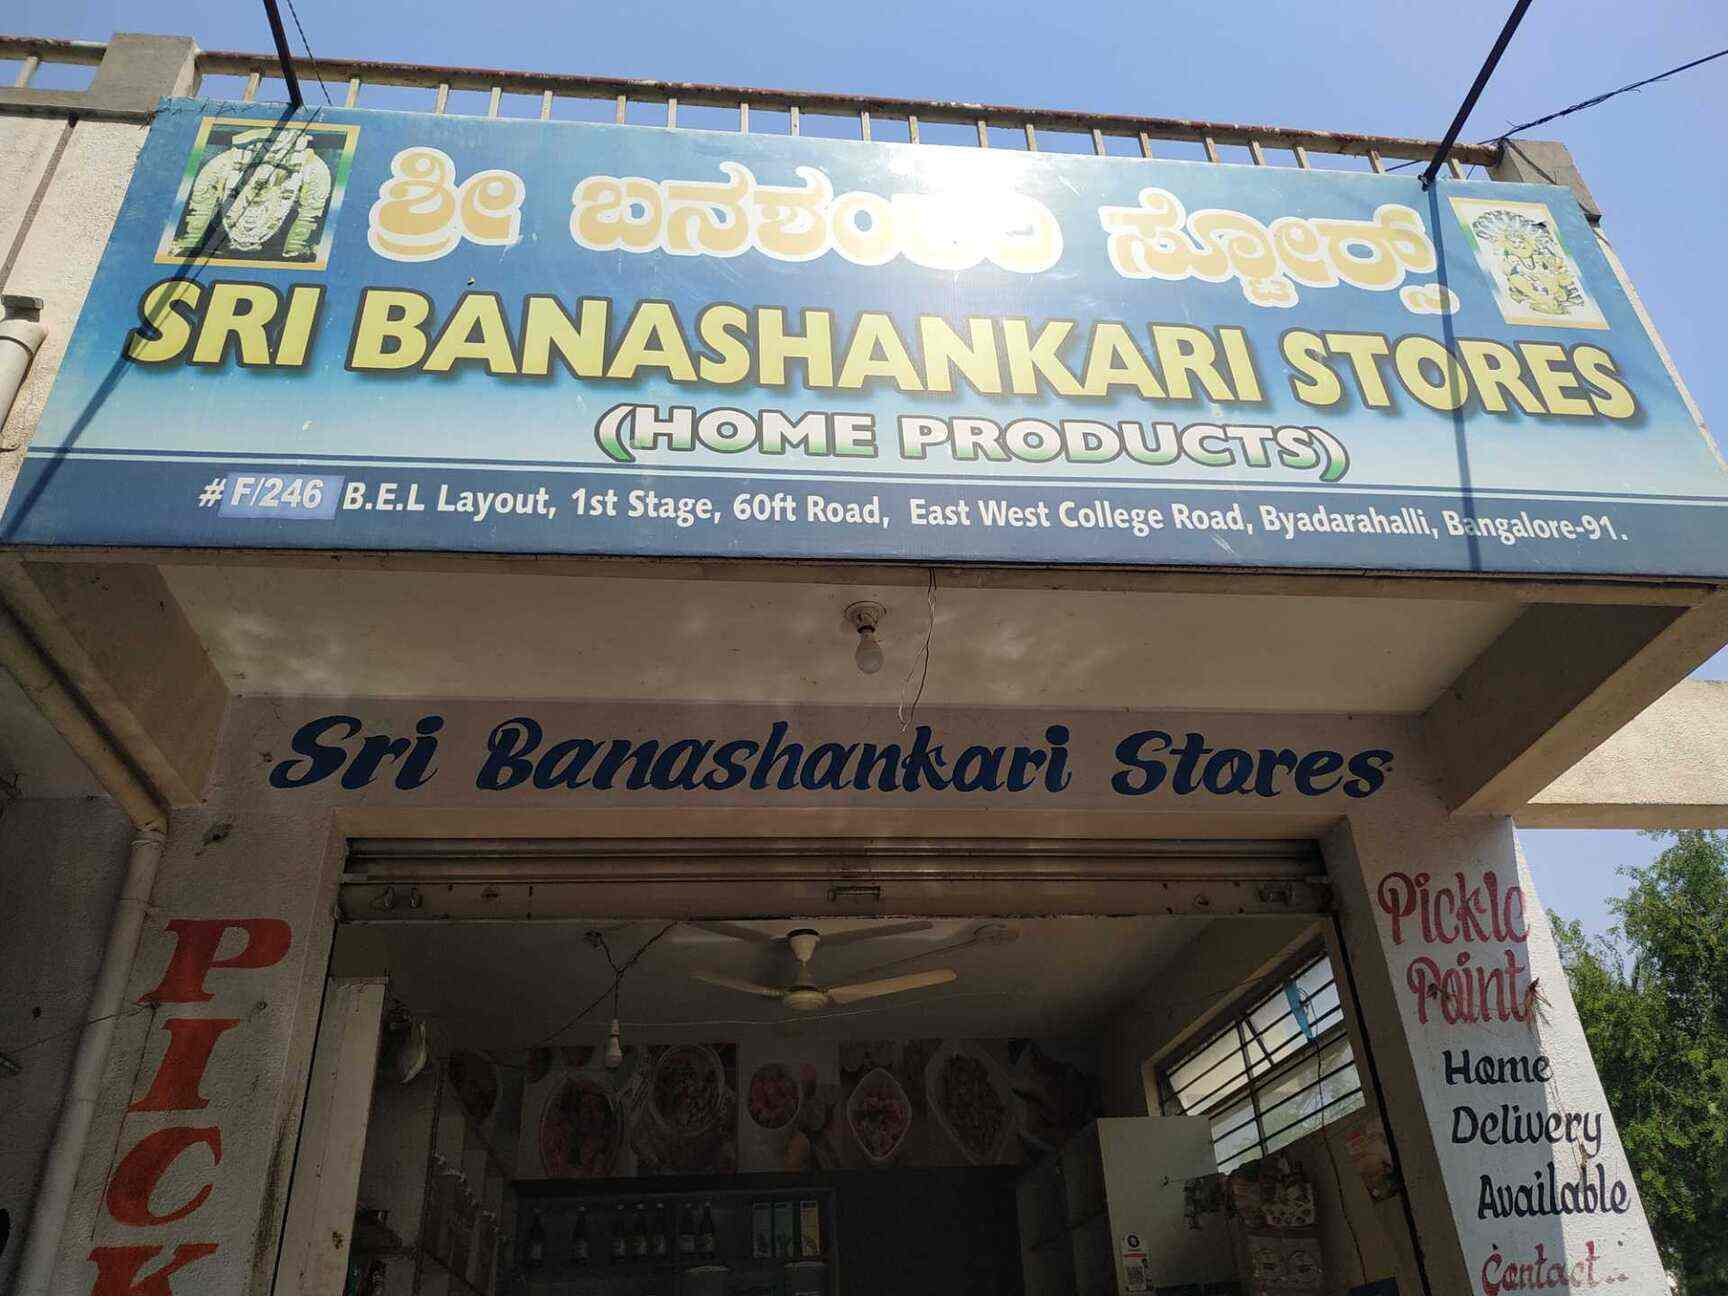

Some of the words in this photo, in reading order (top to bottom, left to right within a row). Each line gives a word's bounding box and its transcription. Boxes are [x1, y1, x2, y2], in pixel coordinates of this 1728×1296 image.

[367, 147, 526, 262] ಶ್ರೀ
[570, 161, 1063, 274] ಬನಶಂರಿ
[128, 278, 325, 368] SRI
[347, 288, 1266, 403] BANASHANKARI
[1280, 328, 1640, 421] STORES
[594, 404, 877, 462] (HOME
[899, 415, 1350, 482] PRODUCTS)
[342, 482, 425, 512] B.E.L
[437, 484, 557, 521] Layout,
[571, 488, 617, 516] 1st
[627, 490, 721, 527] Stage,
[733, 493, 796, 522] 60ft
[807, 496, 889, 529] Road,
[910, 498, 970, 527] East
[977, 499, 1049, 528] West
[1058, 501, 1164, 537] College
[1173, 504, 1254, 536] Road,
[1262, 506, 1439, 541] Byadarahalli,
[1445, 510, 1628, 544] Bangalore-91.
[270, 715, 447, 790] Sri
[475, 718, 1073, 792] Banashankari
[1112, 730, 1393, 797] Stores
[1407, 949, 1530, 1024] Point
[1442, 1050, 1553, 1085] Home
[1451, 1105, 1602, 1158] Delivery
[1477, 1163, 1630, 1219] Available
